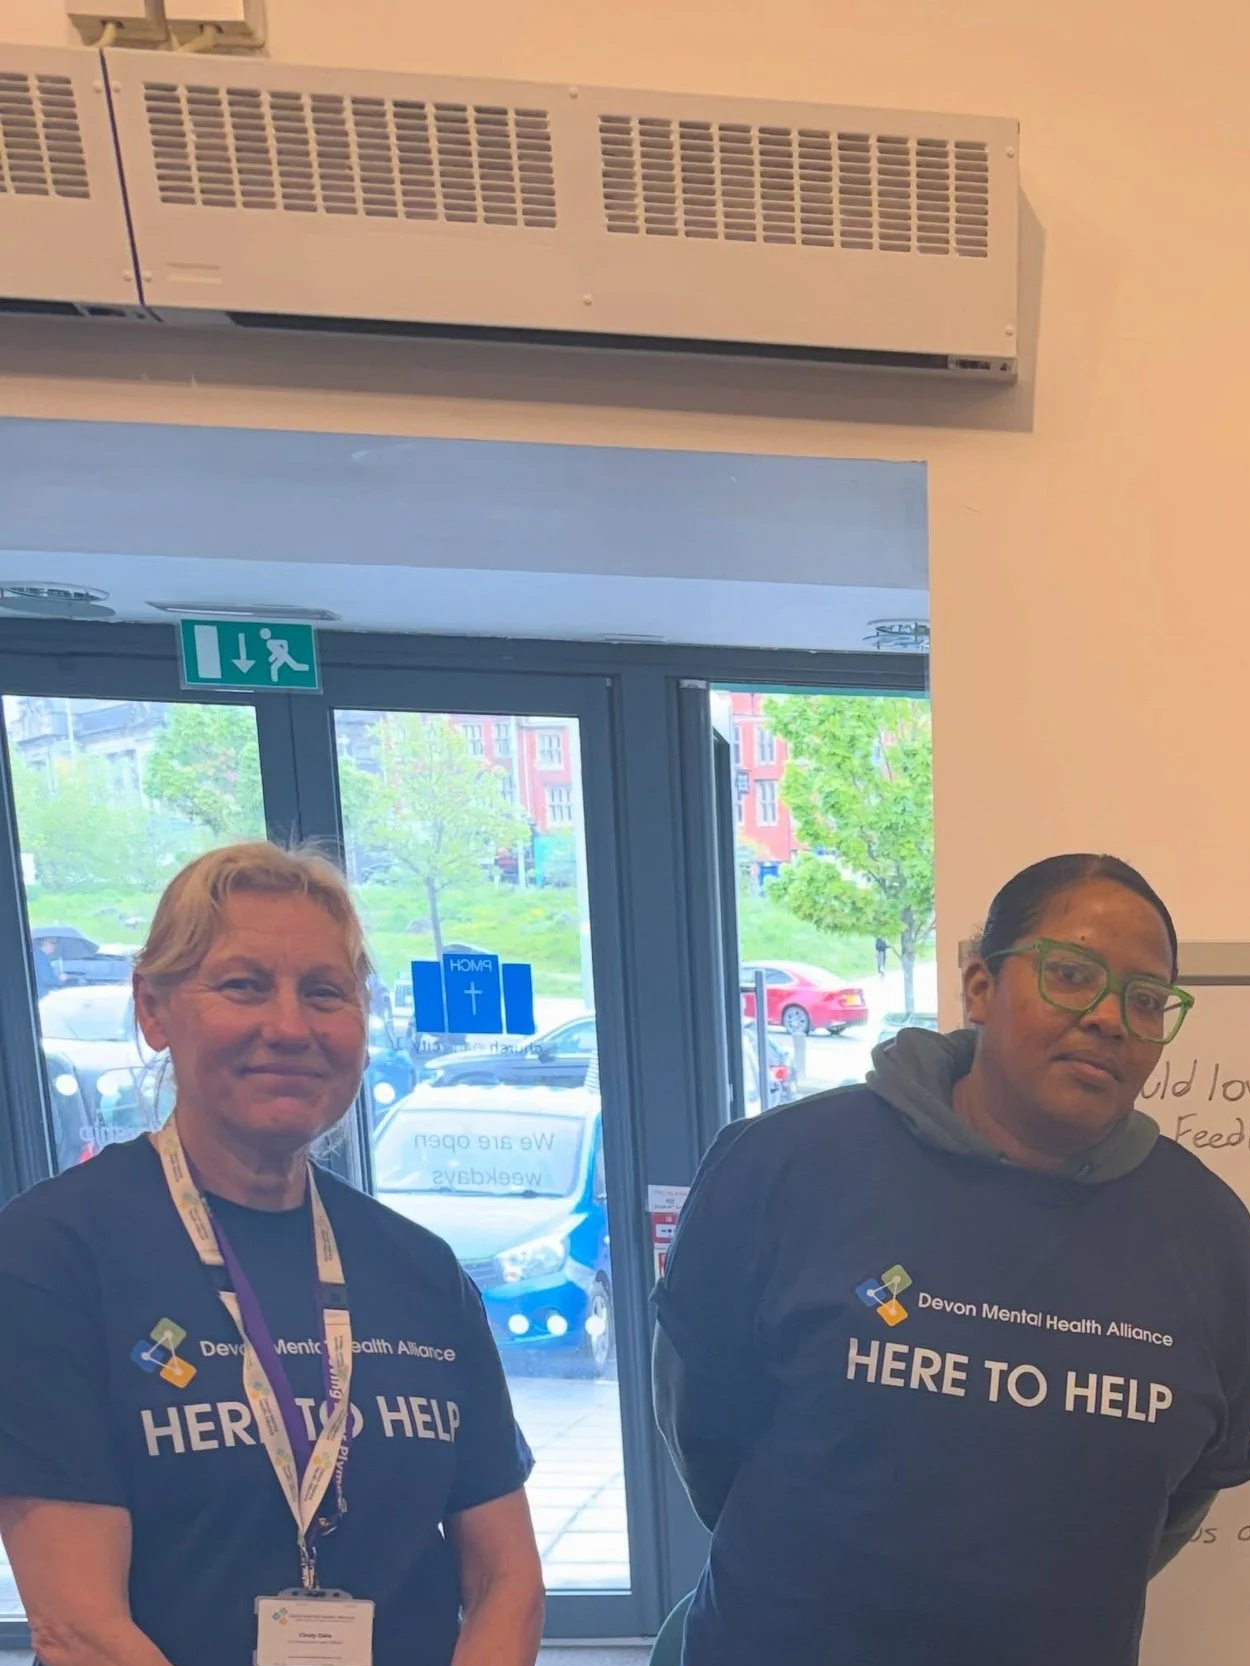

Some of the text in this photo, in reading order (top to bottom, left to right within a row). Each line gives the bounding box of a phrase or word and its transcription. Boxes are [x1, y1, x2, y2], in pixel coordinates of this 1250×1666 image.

[1140, 1059, 1197, 1100] uld
[918, 1292, 1174, 1347] Devon Mental Health Alliance
[199, 1340, 246, 1357] Devo
[273, 1338, 323, 1355] Menta
[352, 1338, 393, 1355] ealth
[397, 1339, 456, 1362] Alliance
[847, 1337, 1174, 1424] HERE TO HELP
[140, 1401, 263, 1457] HER
[375, 1395, 460, 1444] HELP
